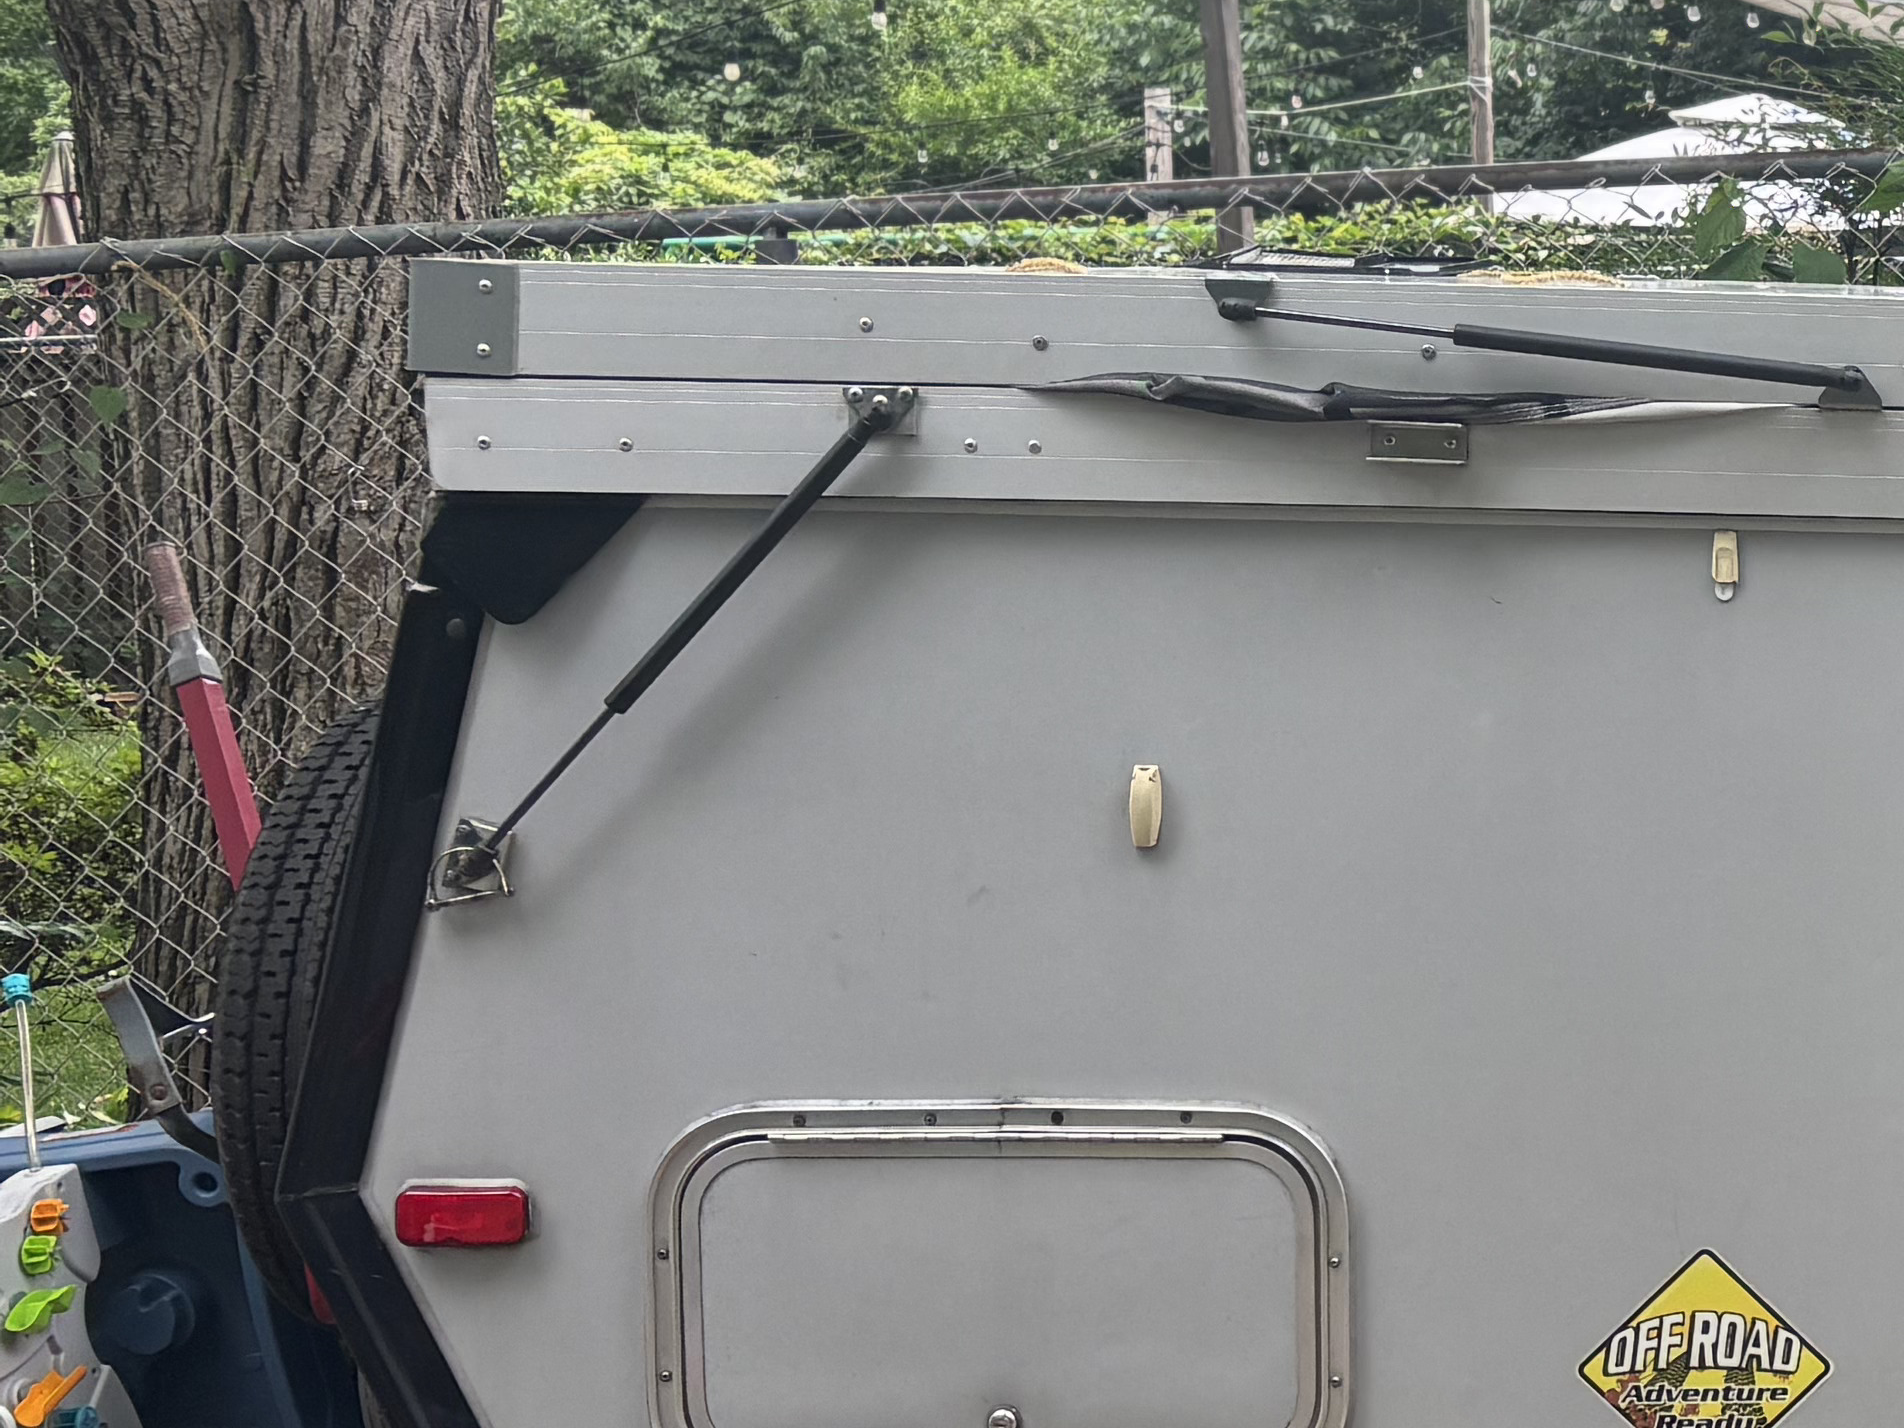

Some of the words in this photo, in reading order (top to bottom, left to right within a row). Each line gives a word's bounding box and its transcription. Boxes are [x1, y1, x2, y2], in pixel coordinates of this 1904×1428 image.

[1605, 1313, 1684, 1375] OFF
[1690, 1311, 1801, 1373] ROAD
[1622, 1385, 1789, 1402] Adventure
